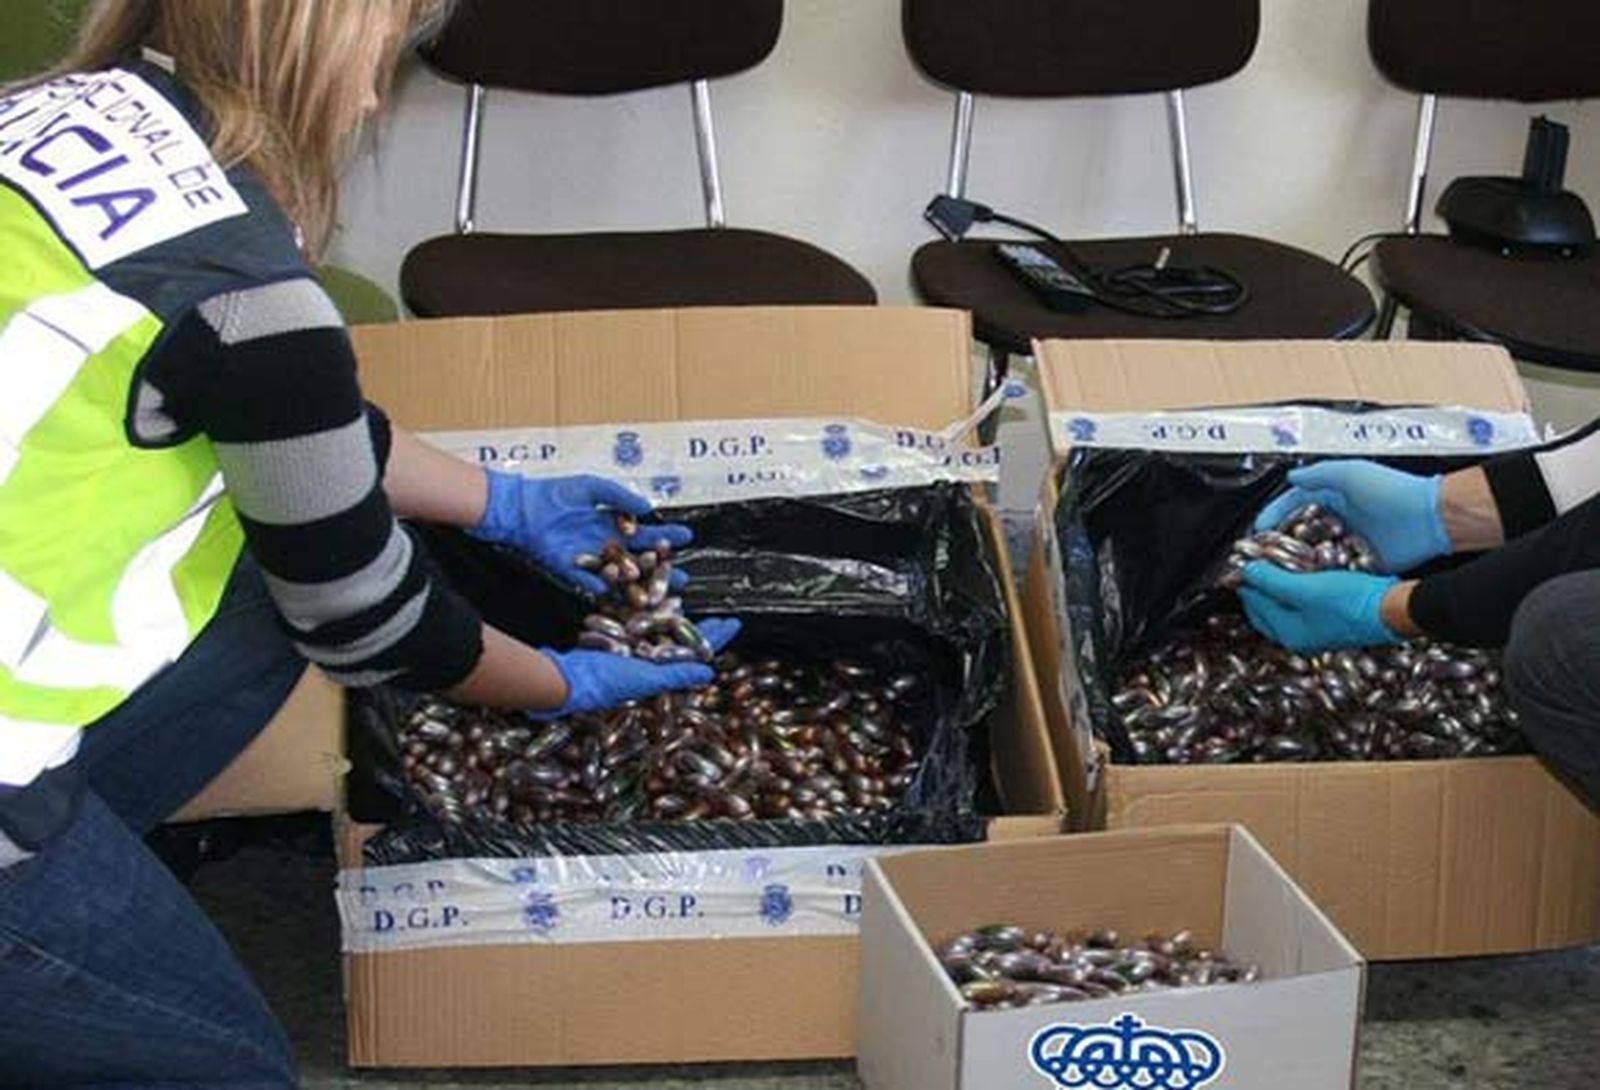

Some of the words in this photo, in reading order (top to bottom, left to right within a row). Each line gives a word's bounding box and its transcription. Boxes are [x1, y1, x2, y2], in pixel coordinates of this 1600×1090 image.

[168, 165, 224, 209] DE
[688, 434, 774, 459] D.G.P.
[373, 905, 469, 932] D.G.P.
[609, 892, 705, 920] D.G.P.
[844, 893, 862, 916] D
